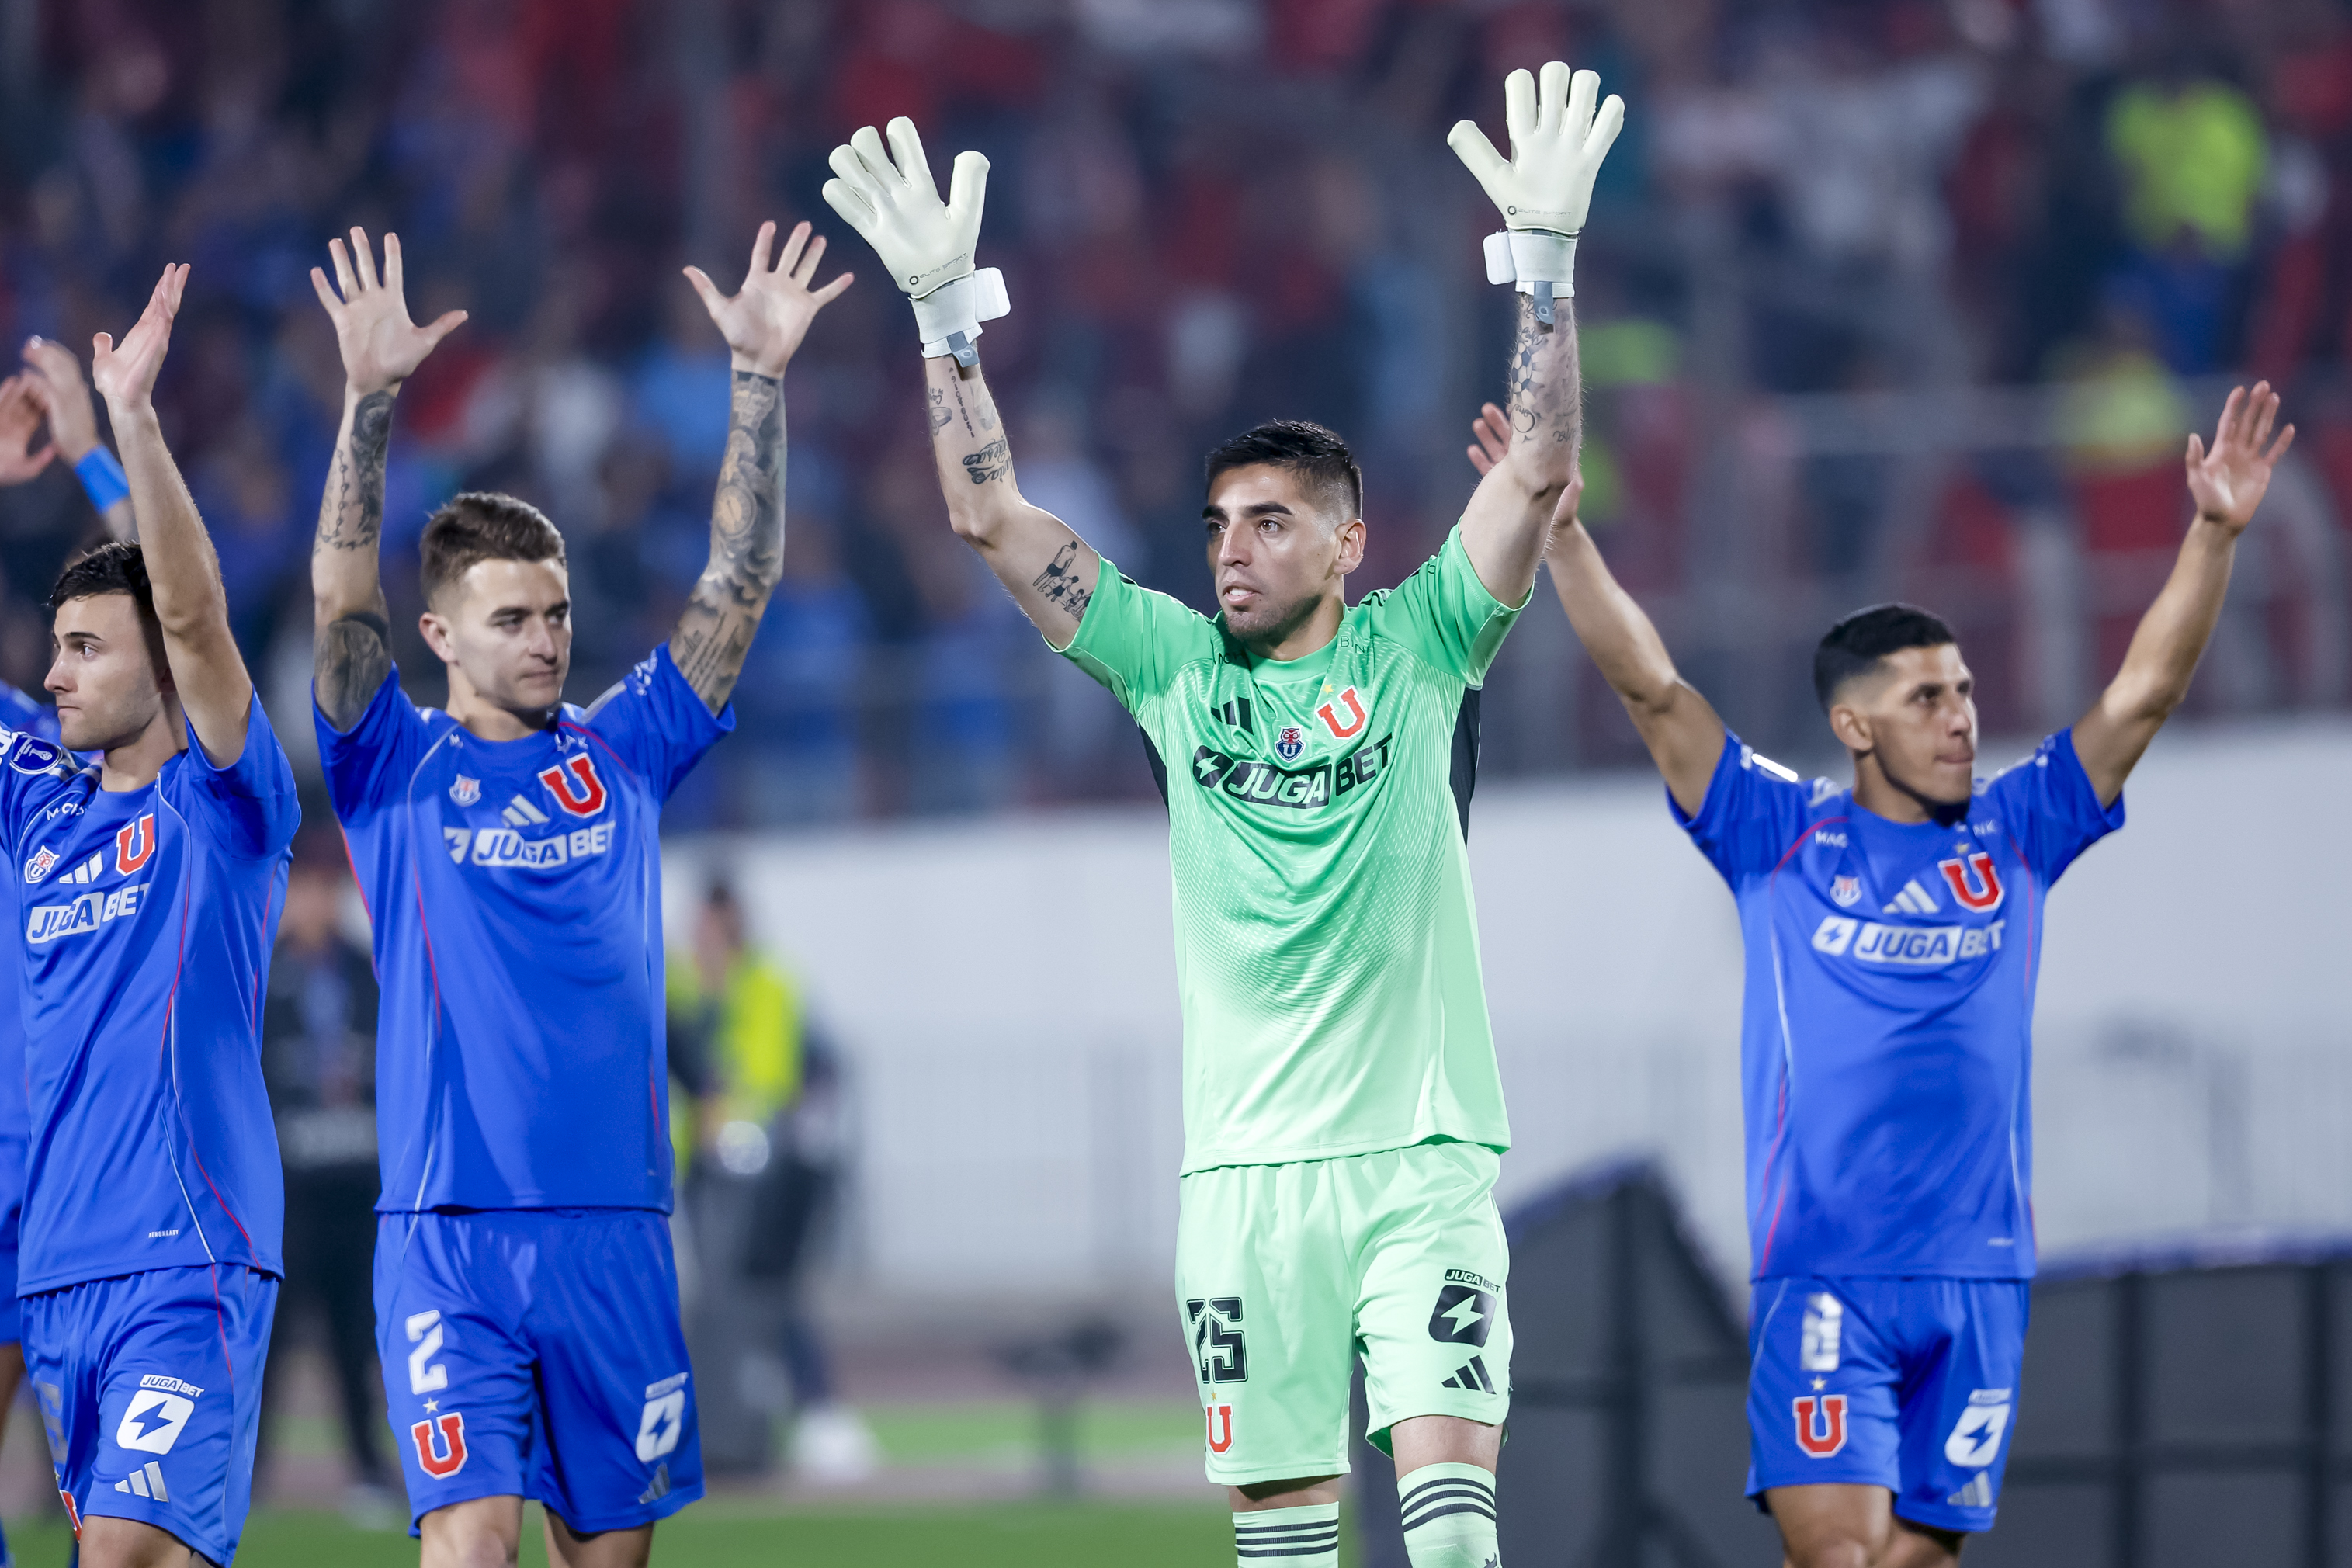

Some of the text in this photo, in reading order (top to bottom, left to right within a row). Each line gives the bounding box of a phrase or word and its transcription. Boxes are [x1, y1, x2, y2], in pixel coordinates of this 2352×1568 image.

[1315, 685, 1366, 740] U
[1283, 744, 1297, 757] U
[537, 752, 607, 819] U
[116, 813, 155, 876] U
[1937, 852, 2005, 914] U
[405, 1310, 448, 1395] 2
[1186, 1296, 1248, 1384] 25
[411, 1411, 469, 1480] U
[1205, 1403, 1234, 1455] U
[1792, 1394, 1848, 1459] U
